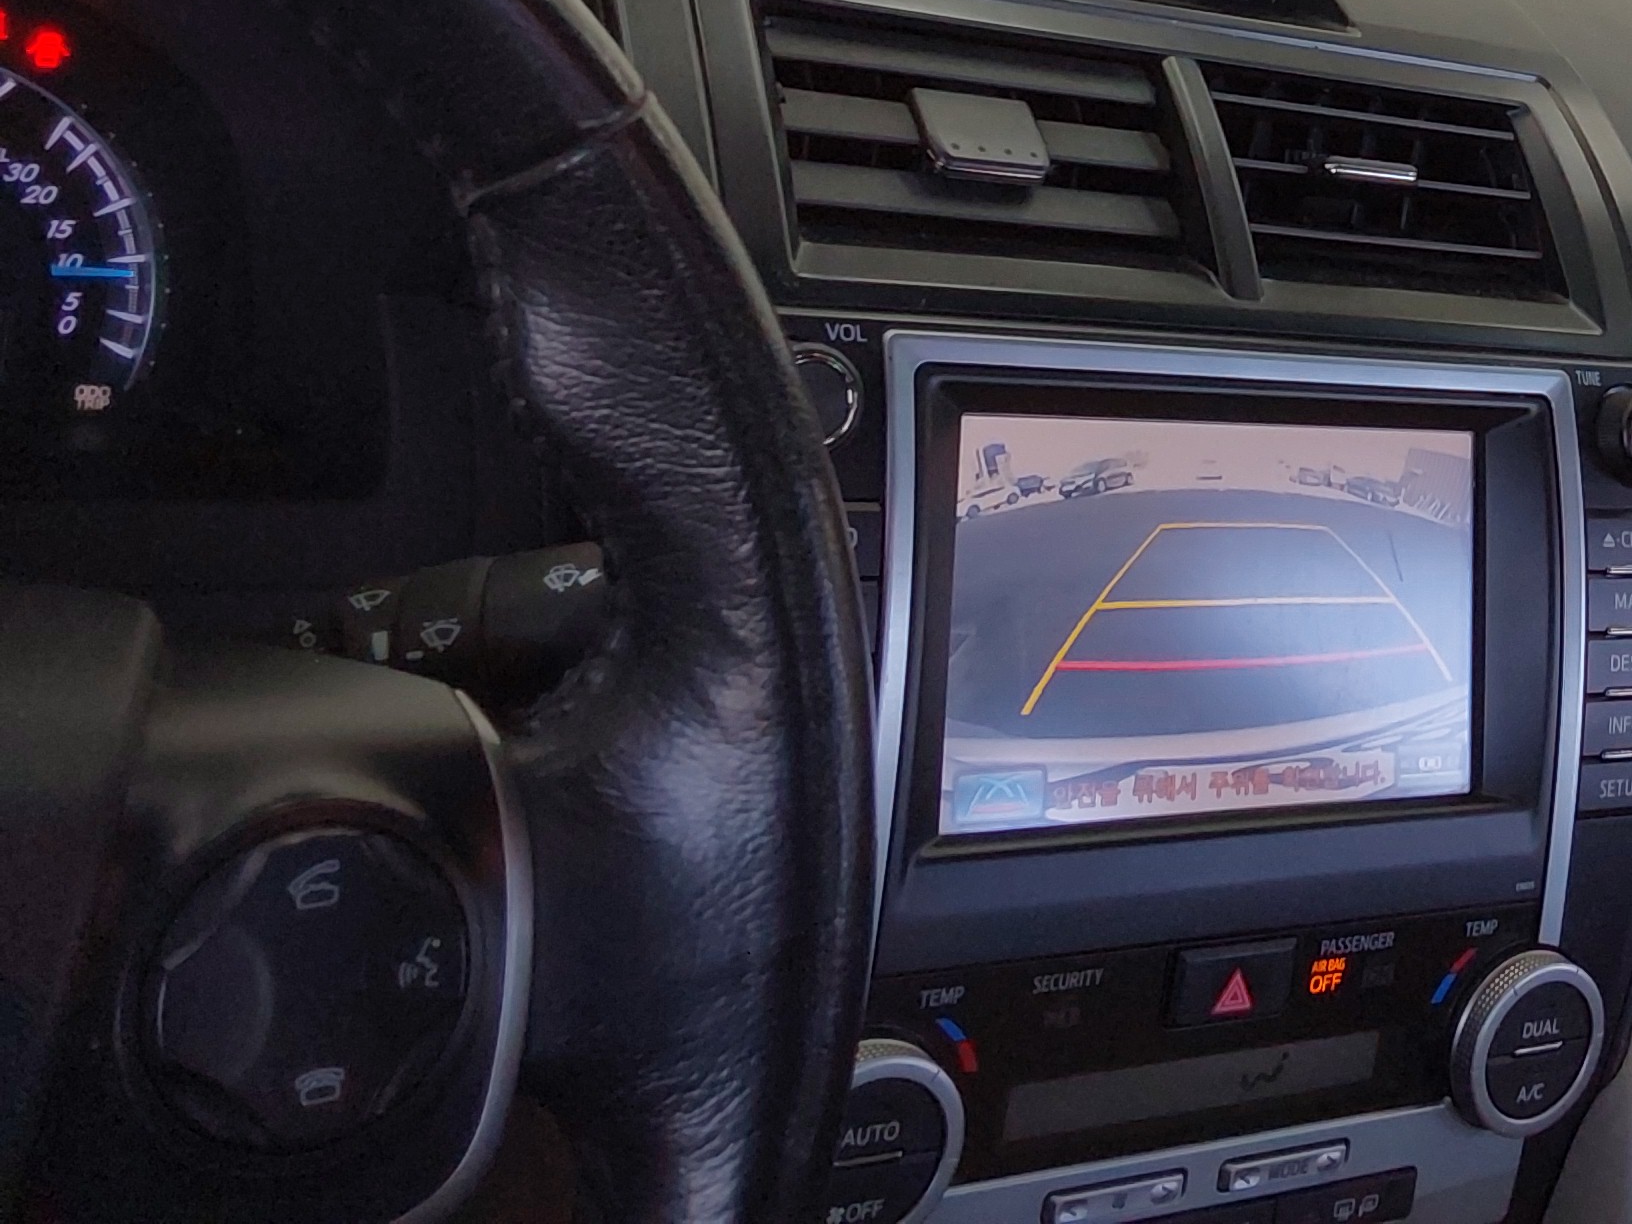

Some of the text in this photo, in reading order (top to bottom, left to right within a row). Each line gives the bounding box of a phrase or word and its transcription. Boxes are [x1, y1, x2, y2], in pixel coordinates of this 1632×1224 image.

[2, 162, 41, 183] 30
[20, 185, 59, 205] 20
[46, 219, 77, 239] 15
[56, 253, 84, 269] 10
[61, 291, 83, 311] 5
[57, 315, 77, 335] 0
[825, 323, 867, 343] VOL
[1575, 369, 1601, 386] TUNE
[74, 384, 111, 400] ODO
[75, 398, 111, 411] TRIP
[1465, 918, 1499, 938] TEMP
[1320, 931, 1395, 955] PASSENGER
[1311, 956, 1346, 972] AIR BAG
[1032, 968, 1105, 995] SECURITY
[1309, 972, 1343, 994] OFF
[919, 986, 966, 1009] TEMP
[1522, 1018, 1561, 1039] DUAL
[1515, 1083, 1546, 1104] A/C
[841, 1121, 900, 1149] AUTO
[846, 1198, 886, 1223] OFF
